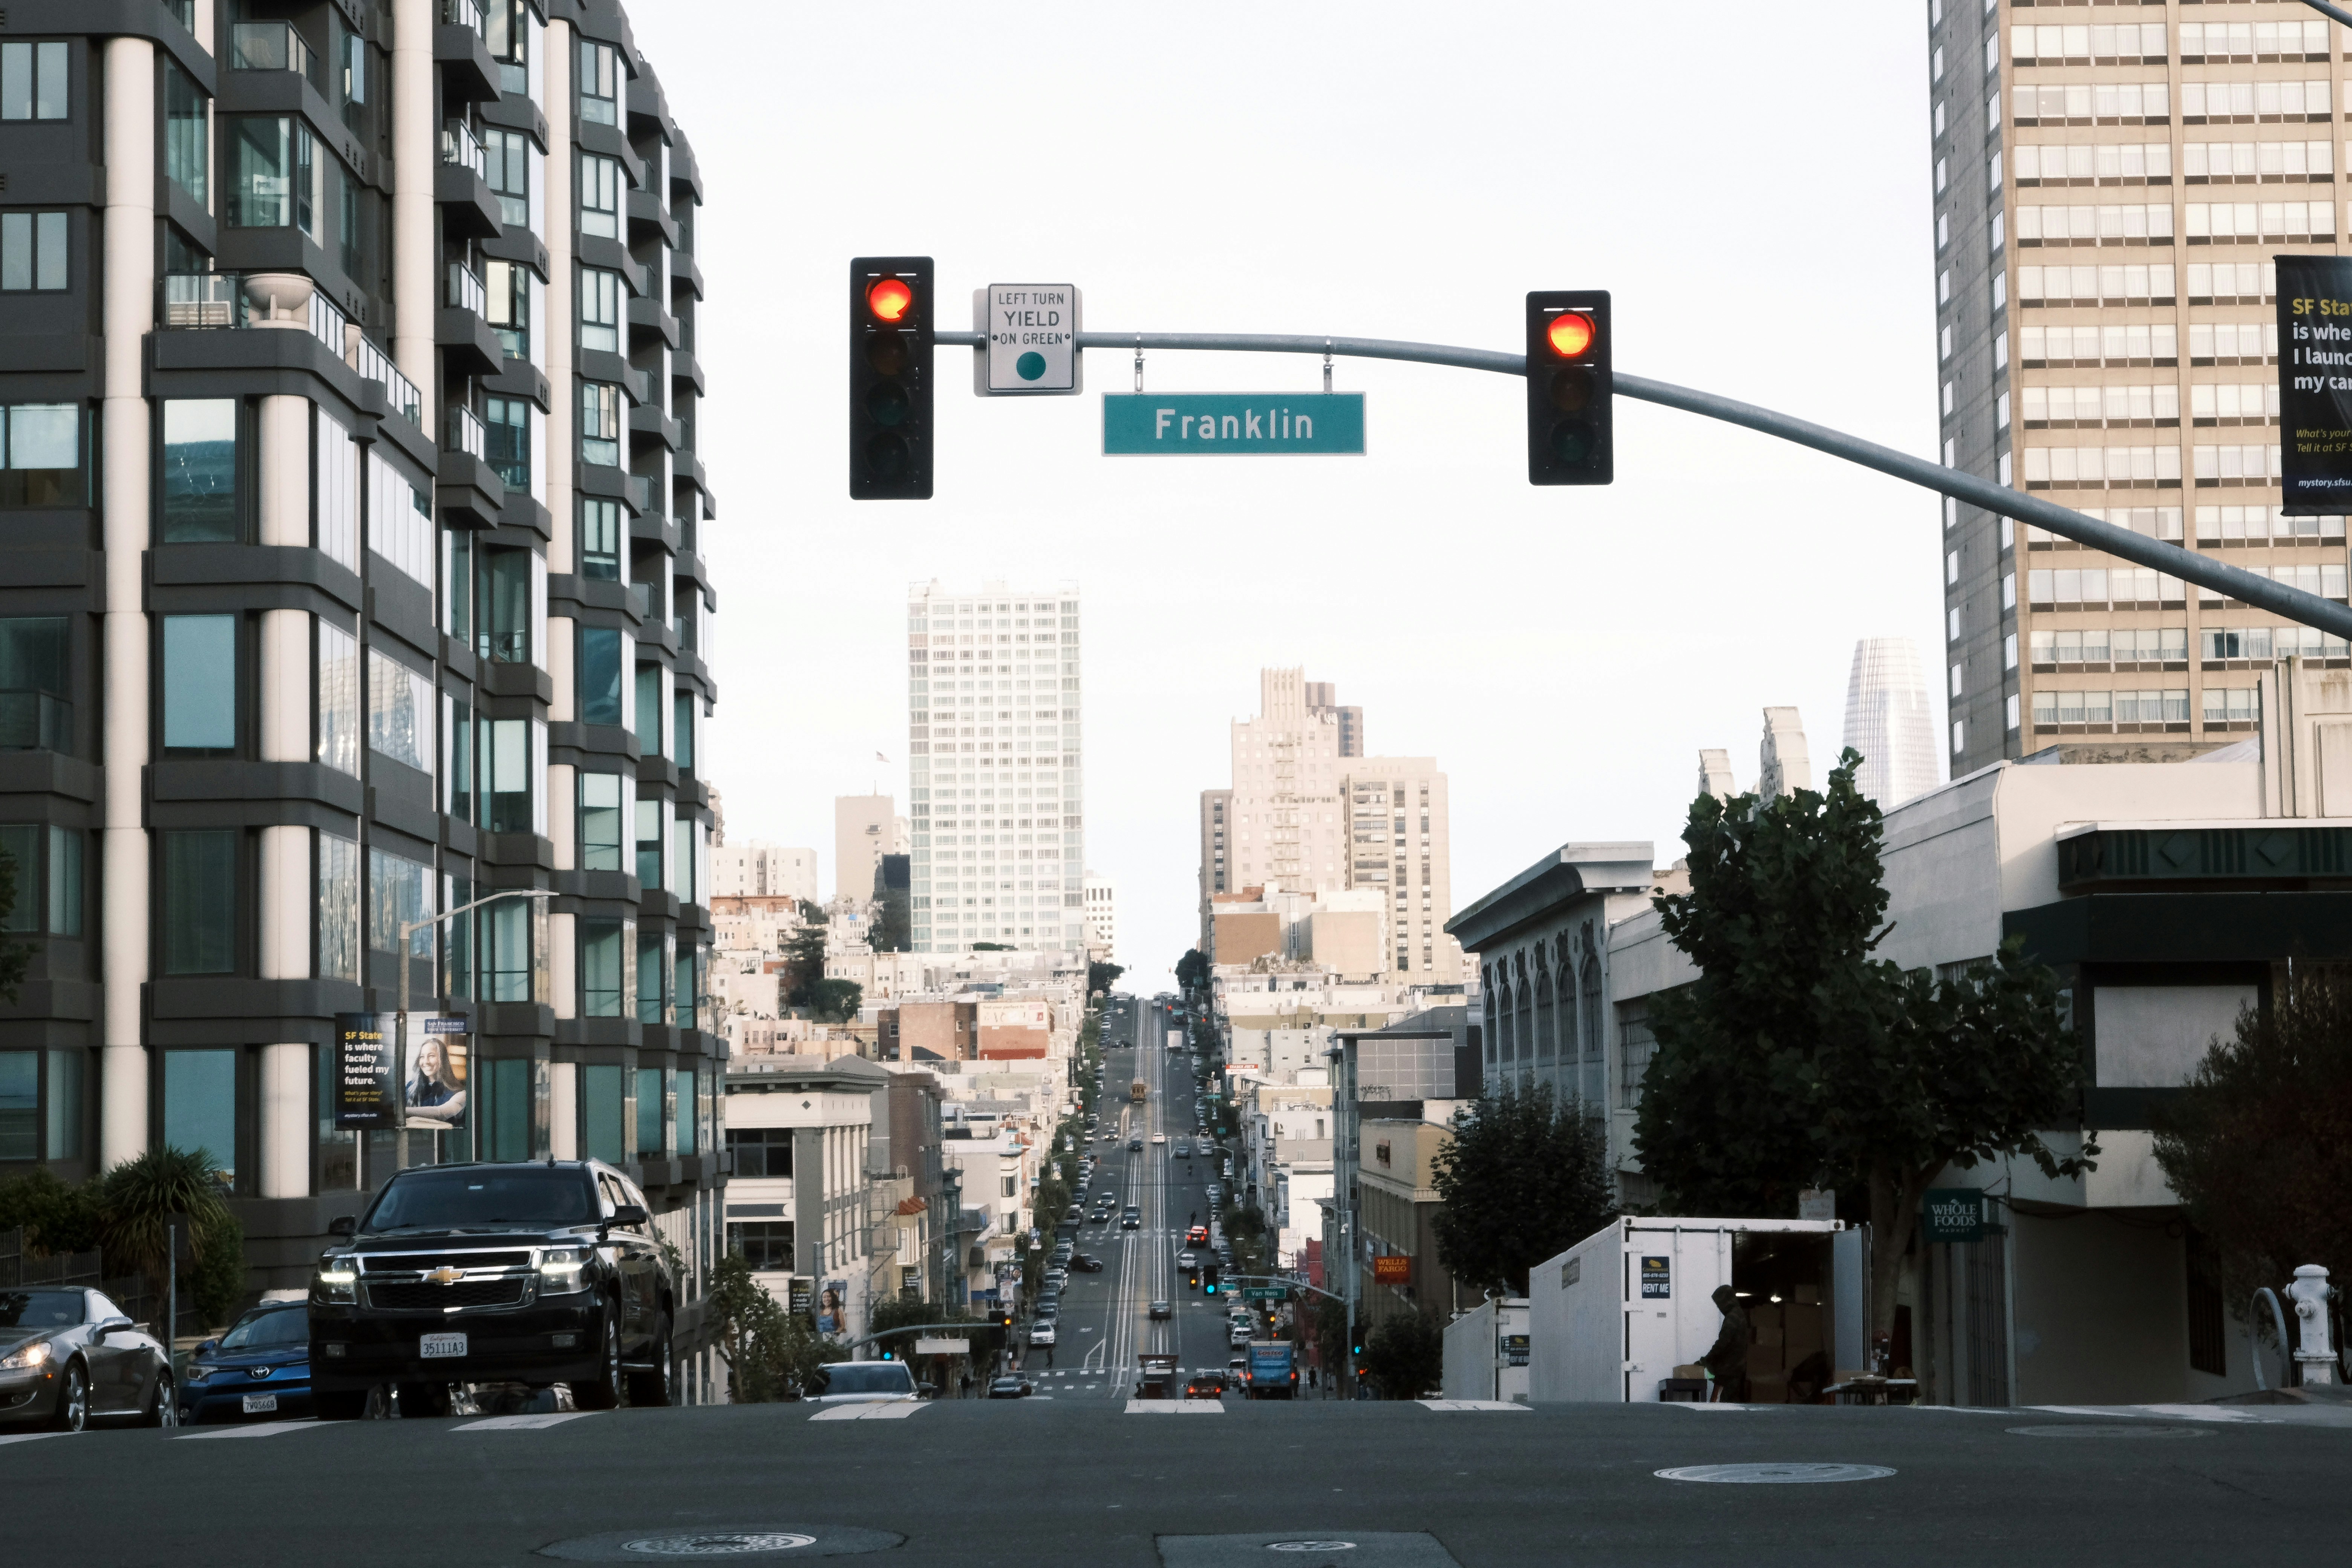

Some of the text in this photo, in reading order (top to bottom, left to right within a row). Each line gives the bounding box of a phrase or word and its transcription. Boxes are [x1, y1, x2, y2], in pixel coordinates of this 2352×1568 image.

[999, 293, 1064, 305] LEFT TURN
[2293, 298, 2352, 316] SF Sta
[1004, 311, 1060, 326] YIELD
[2293, 322, 2309, 340] is
[1000, 332, 1062, 345] ON GREEN
[2294, 348, 2299, 364] I
[2294, 376, 2324, 394] my
[1156, 408, 1312, 439] Franklin
[2296, 429, 2351, 439] What's your
[2297, 443, 2312, 452] Tell
[2314, 443, 2320, 452] it
[2323, 443, 2333, 452] at
[2335, 443, 2347, 452] SF
[359, 1031, 383, 1040] State
[345, 1043, 383, 1051] is where
[345, 1054, 377, 1064] faculty
[345, 1065, 373, 1074] fueled
[345, 1076, 376, 1085] future.
[1931, 1203, 1977, 1215] WHOLE
[1935, 1216, 1976, 1227] FOODS
[1643, 1283, 1669, 1293] RENT ME
[424, 1342, 464, 1354] 35111A3
